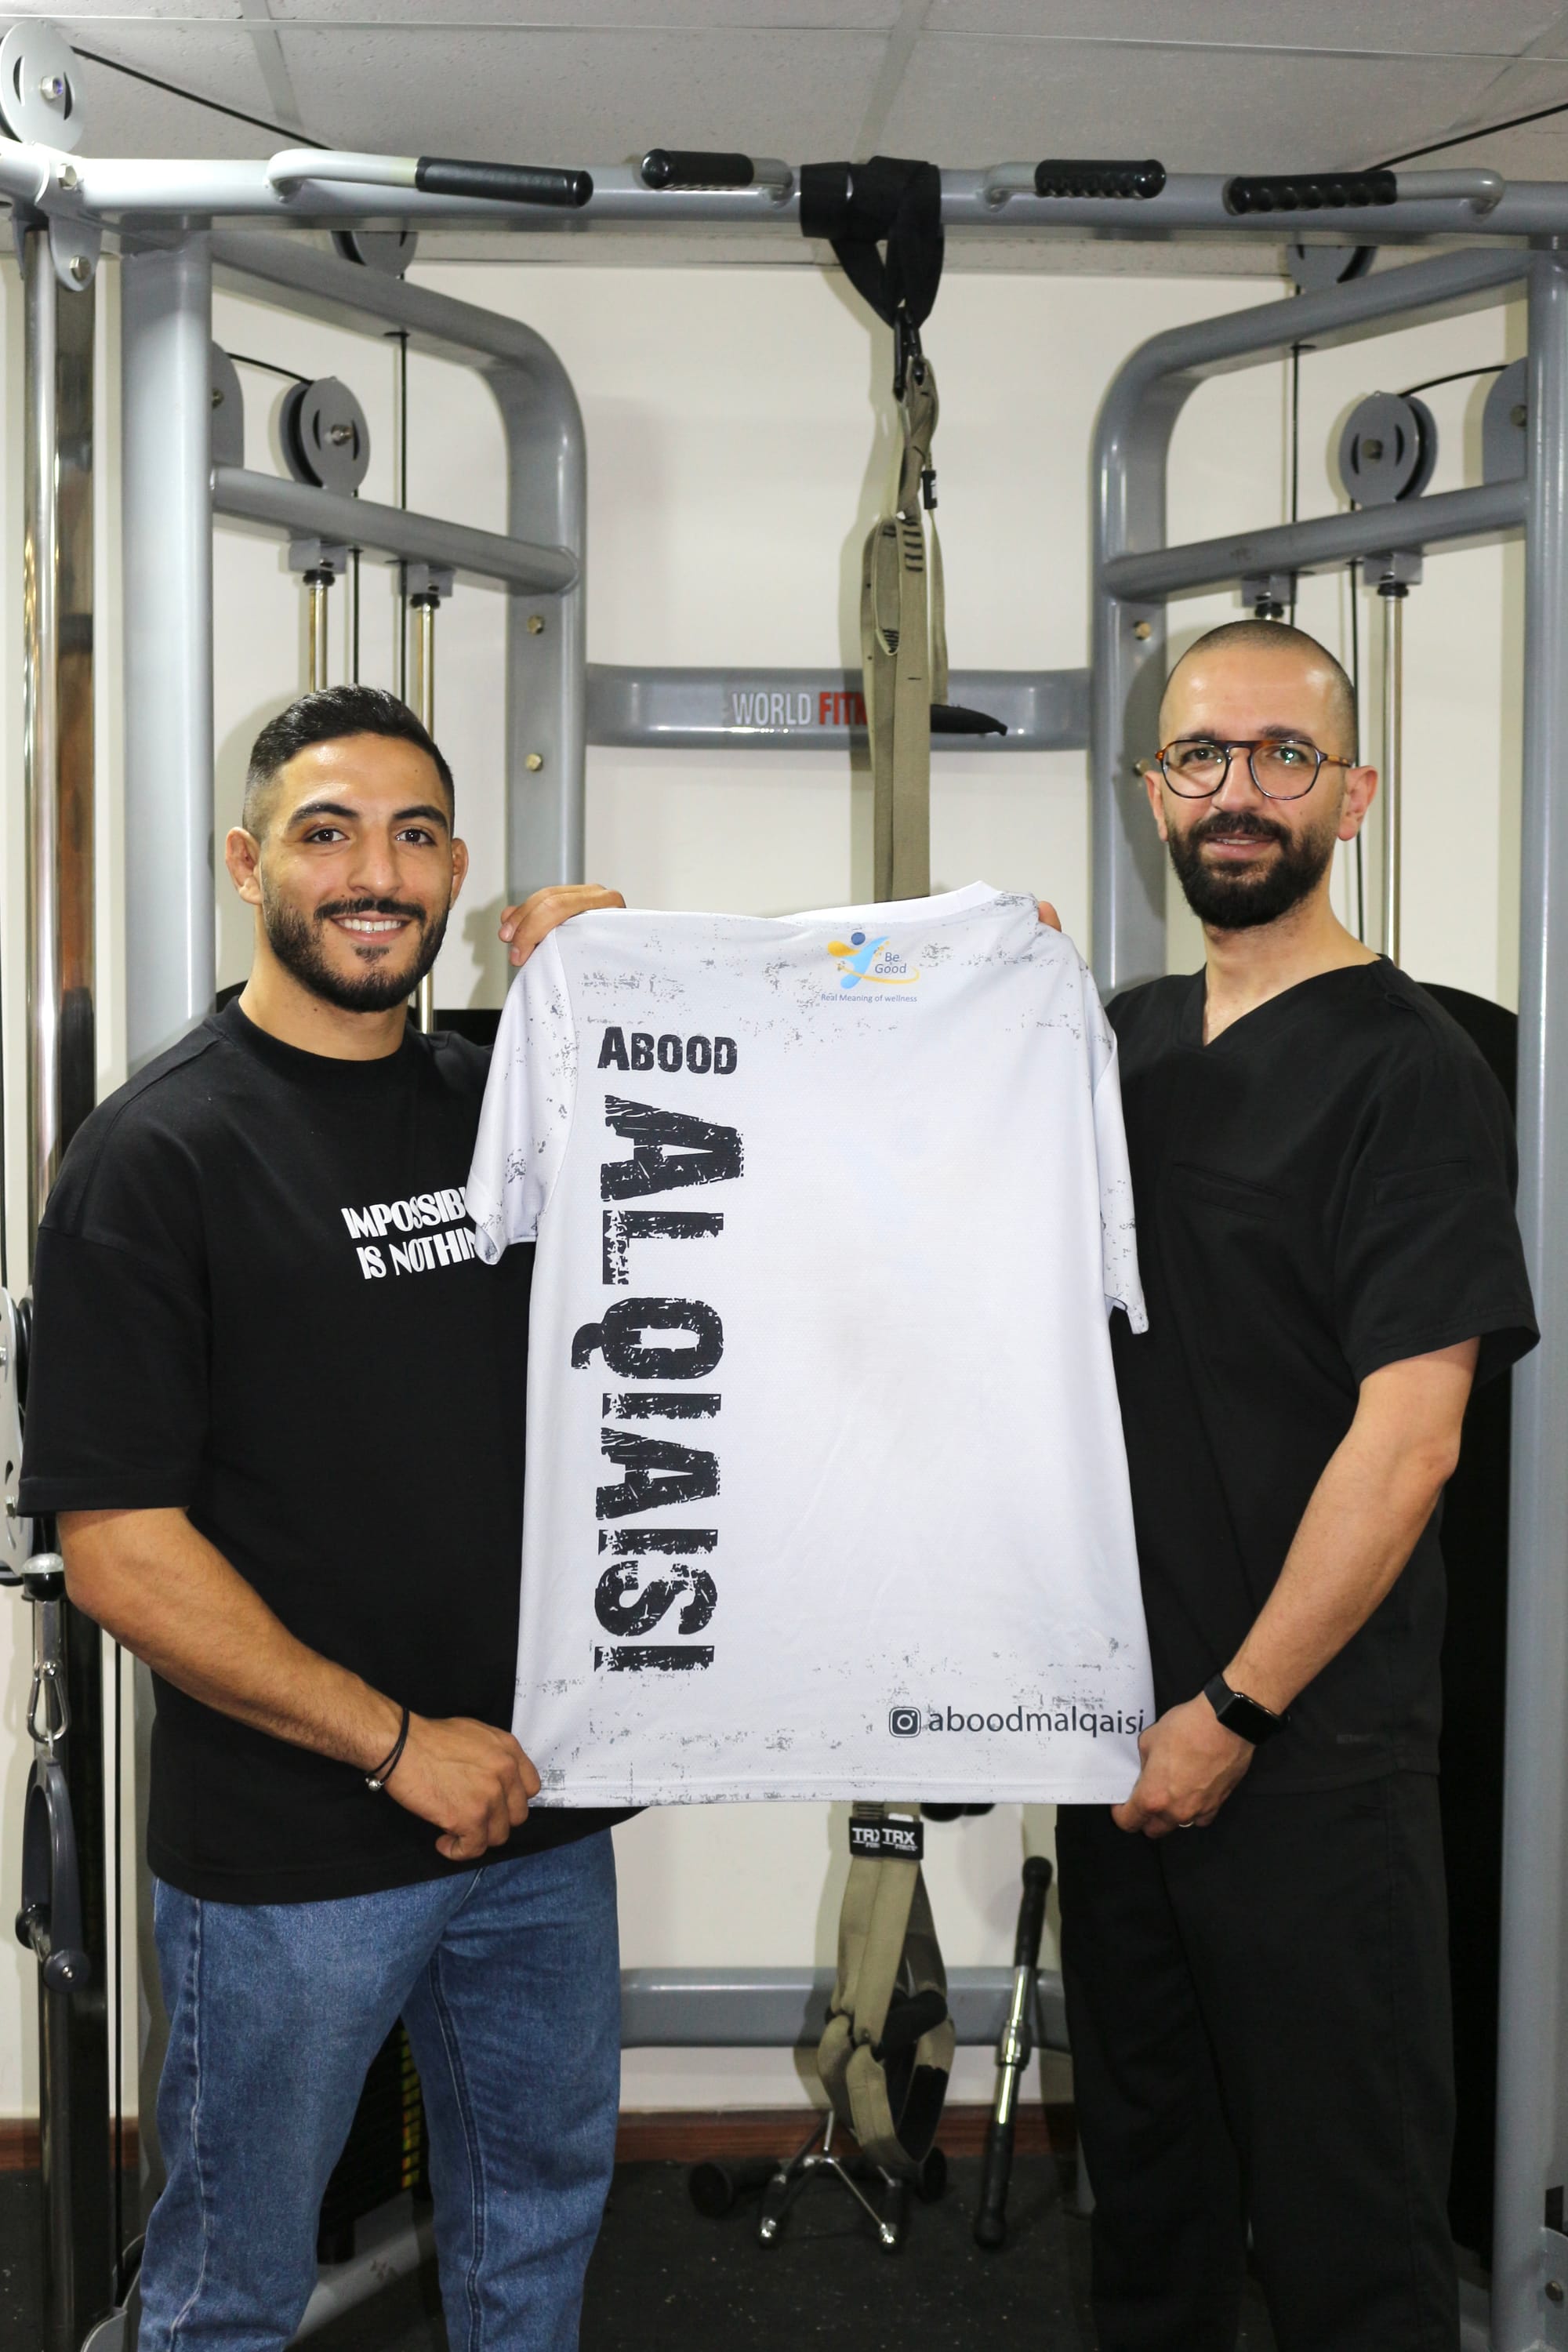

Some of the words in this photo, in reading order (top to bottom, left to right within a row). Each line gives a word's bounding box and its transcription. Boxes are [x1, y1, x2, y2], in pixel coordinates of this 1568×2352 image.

[732, 692, 811, 725] WORLD
[875, 964, 906, 974] Good
[884, 952, 900, 962] Be
[839, 994, 873, 1003] Meaning
[597, 1026, 738, 1075] ABOOD
[356, 1246, 387, 1279] IS
[572, 1094, 744, 1671] ALQIAISI
[928, 1706, 1144, 1737] aboodmalqaisi
[882, 1828, 916, 1845] TRX
